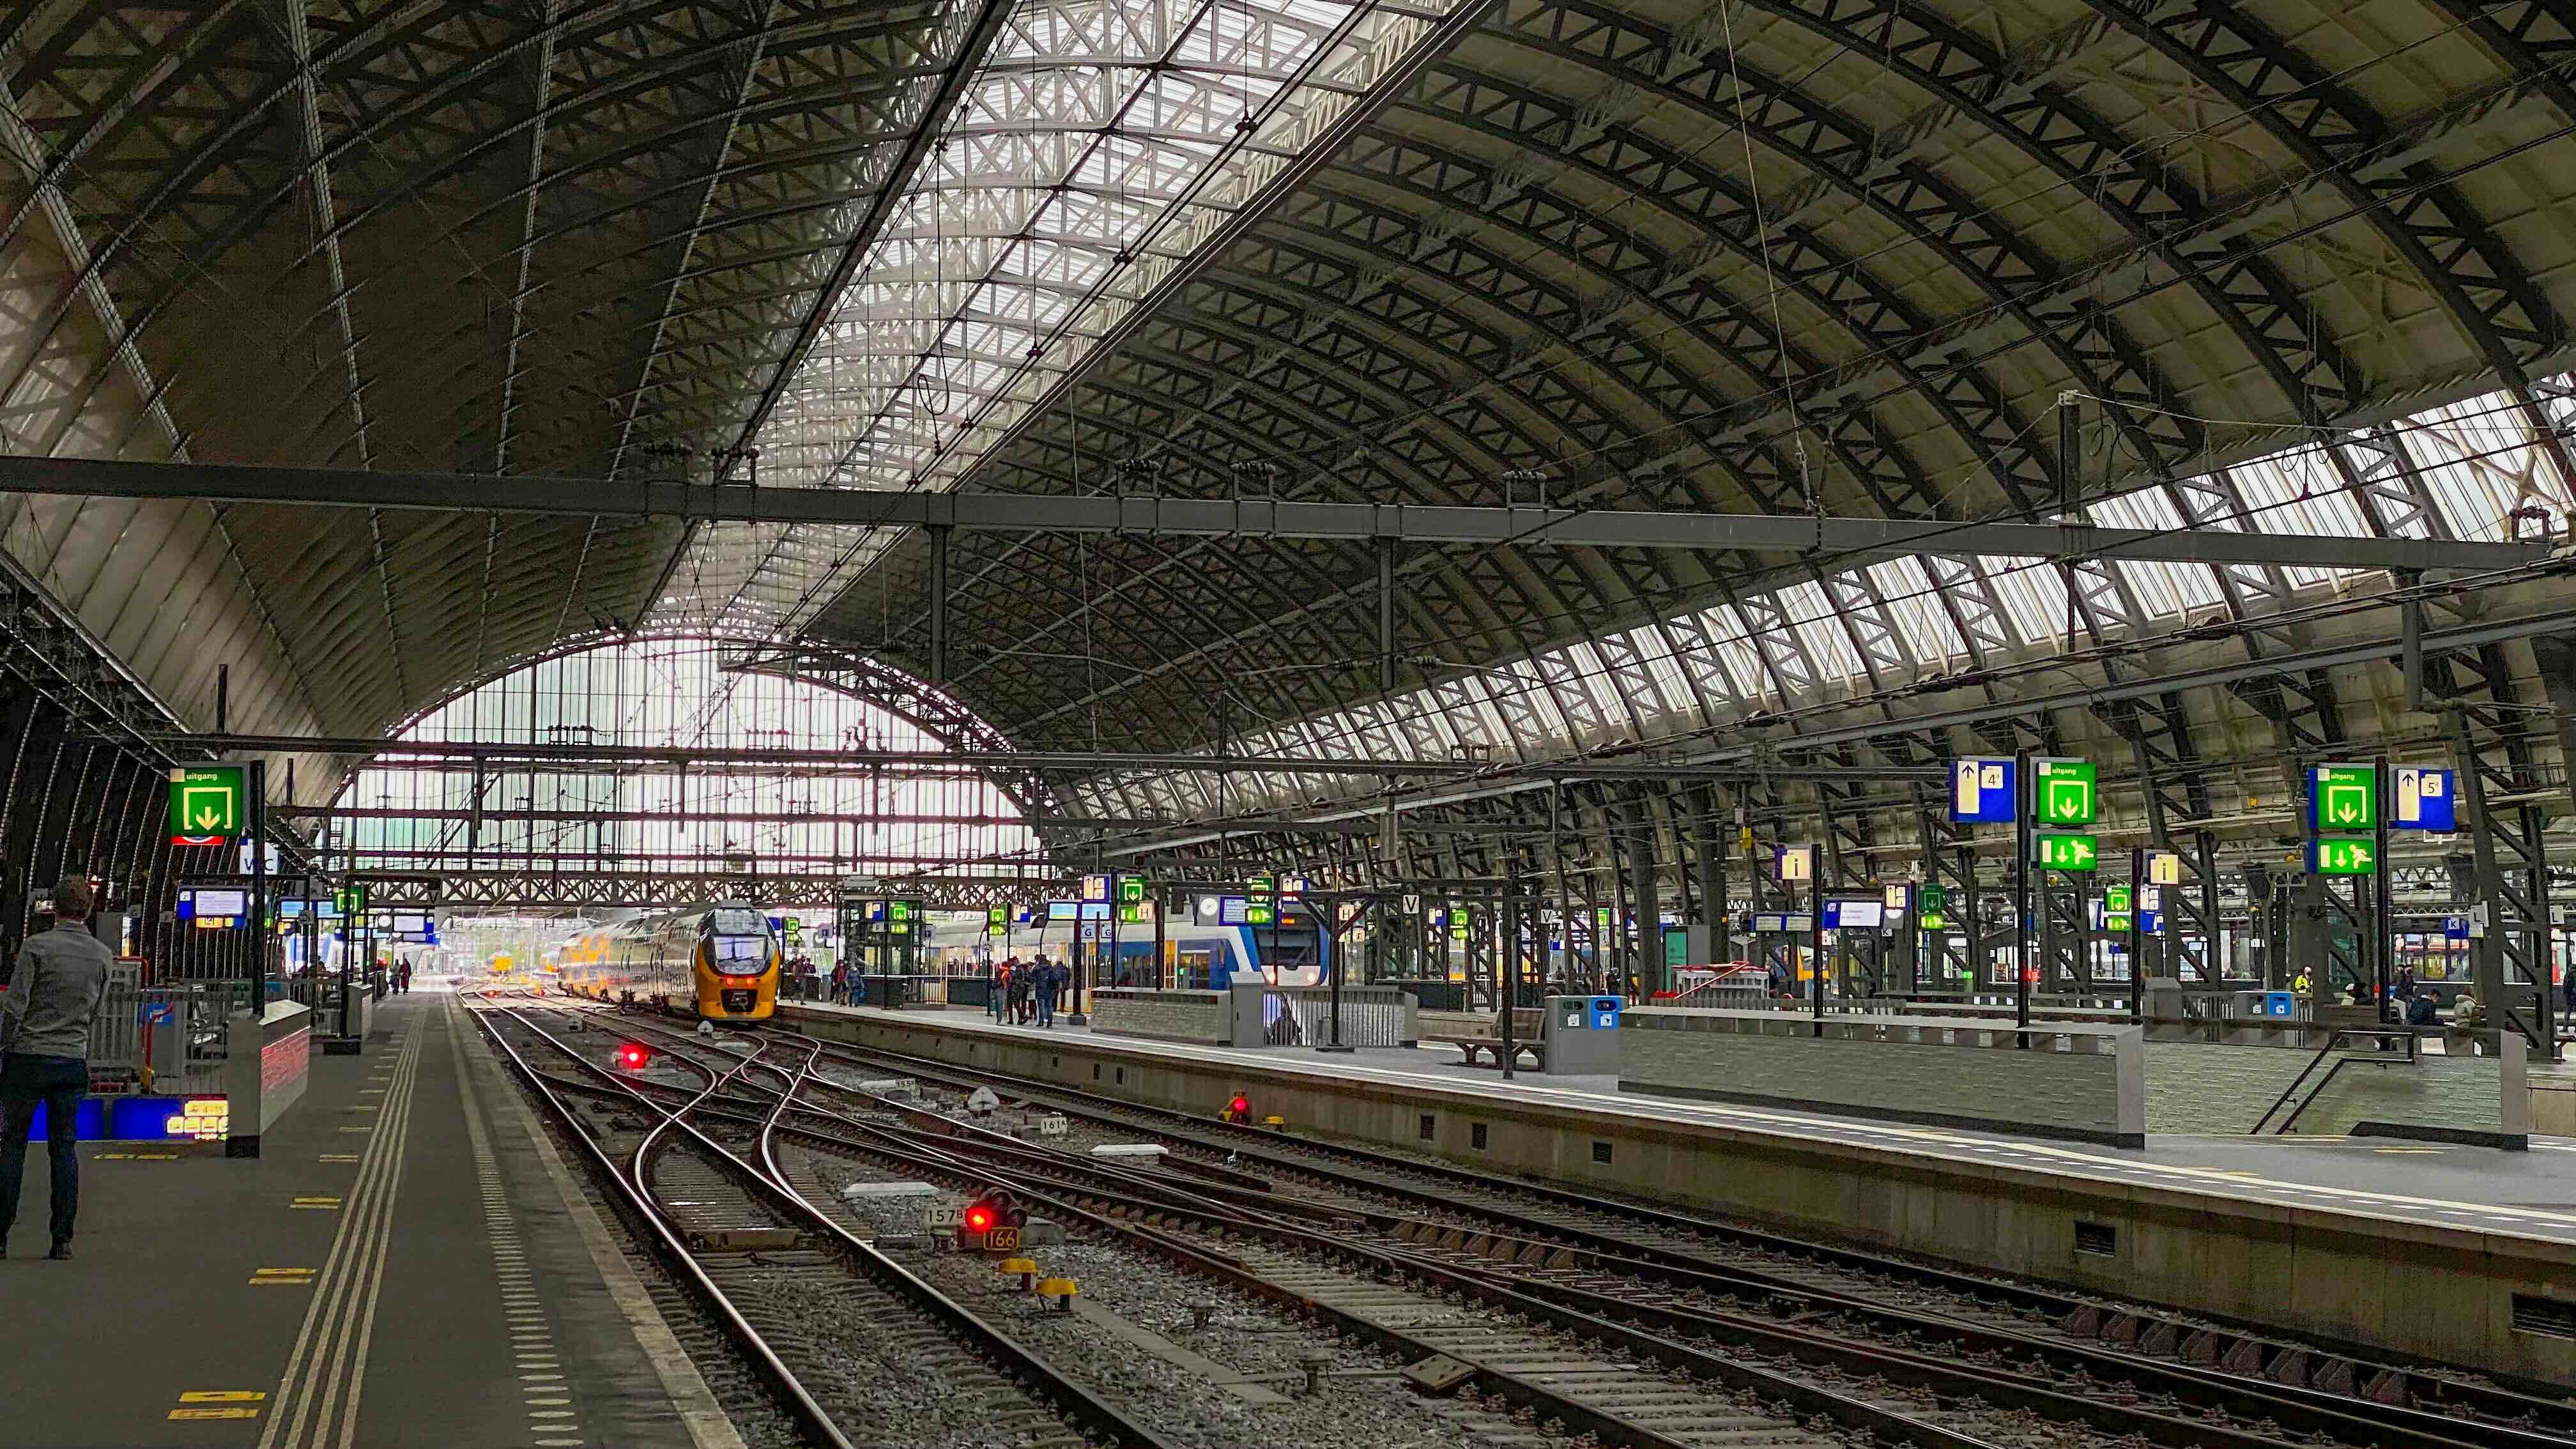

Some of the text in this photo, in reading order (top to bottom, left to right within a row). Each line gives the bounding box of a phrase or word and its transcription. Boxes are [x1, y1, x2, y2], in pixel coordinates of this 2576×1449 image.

[186, 772, 218, 781] uitgang
[2051, 767, 2076, 776] uitgang
[2330, 772, 2356, 781] uitgang
[1405, 896, 1418, 912] V
[1140, 908, 1149, 920] H
[1342, 909, 1350, 920] H
[1542, 910, 1552, 923] V
[2474, 912, 2481, 923] L
[2552, 912, 2559, 923] L
[1084, 928, 1092, 937] G
[1044, 1120, 1066, 1130] 161A
[928, 1209, 963, 1222] 157B
[990, 1231, 1015, 1246] 166
